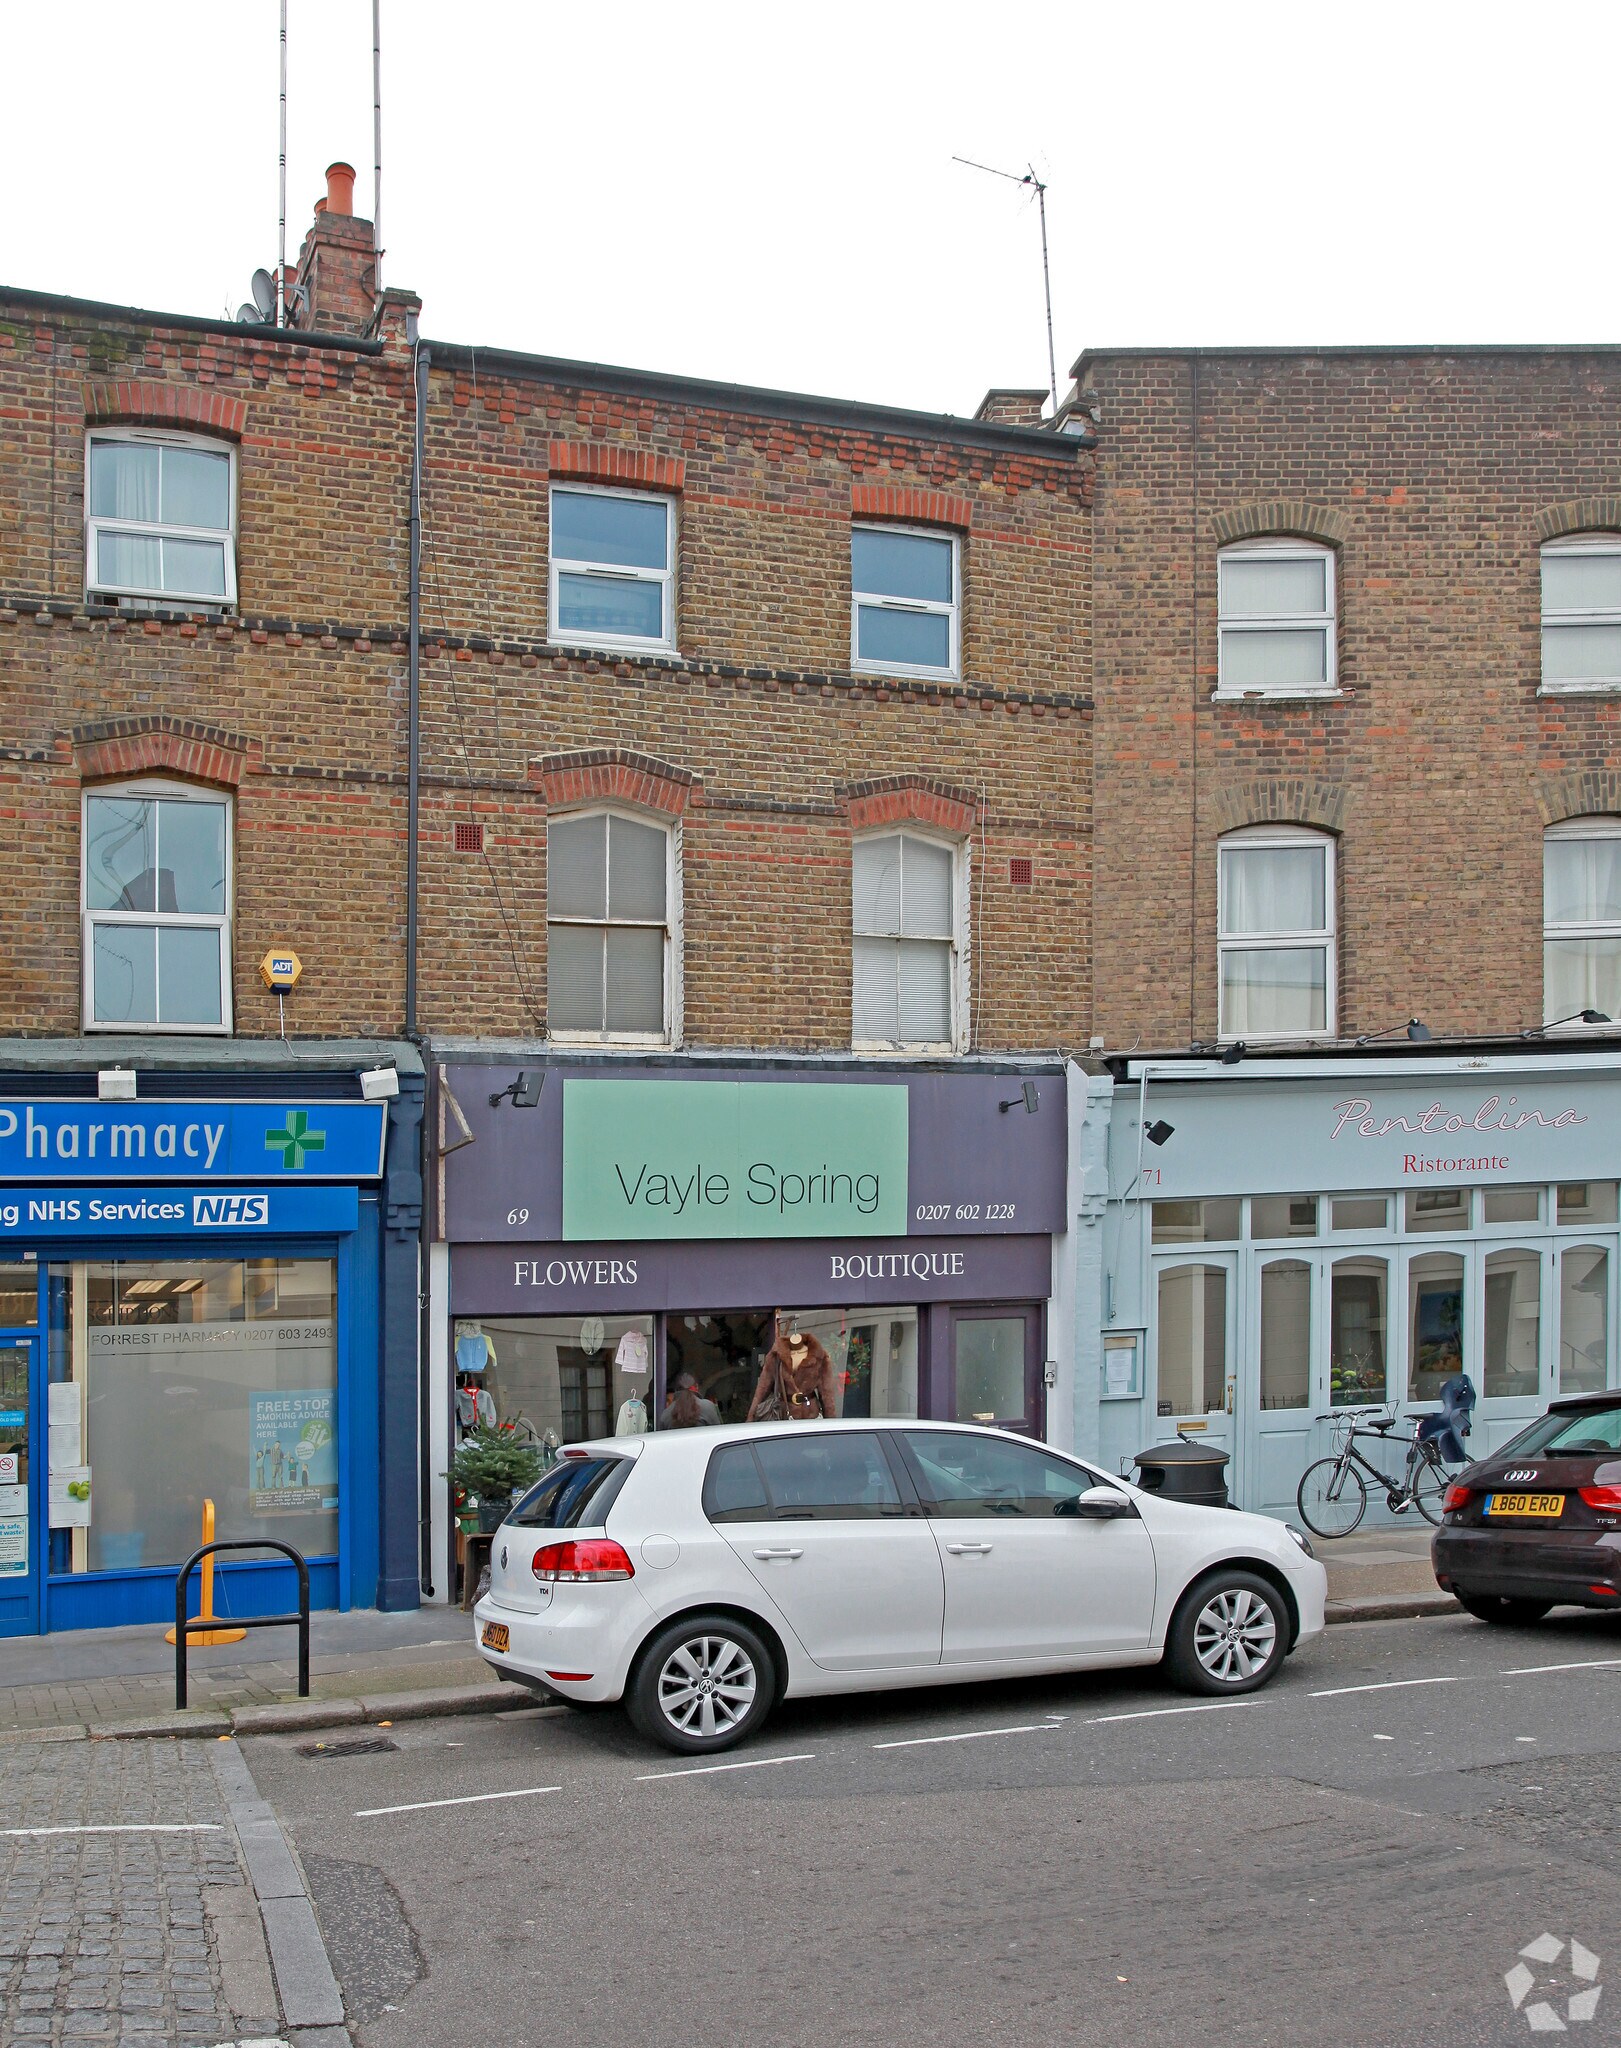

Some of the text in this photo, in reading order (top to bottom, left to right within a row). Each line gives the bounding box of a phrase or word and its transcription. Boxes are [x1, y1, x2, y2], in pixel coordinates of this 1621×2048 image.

[272, 962, 292, 971] ADT
[1330, 1095, 1588, 1140] Pentolina
[0, 1106, 225, 1169] Pharmacy
[1402, 1154, 1509, 1174] Ristorante
[1142, 1168, 1161, 1185] 71
[615, 1163, 880, 1215] Vayle Spring
[0, 1198, 185, 1226] g NHS Services
[195, 1197, 266, 1224] NHS
[506, 1208, 529, 1225] 69
[916, 1204, 1015, 1220] 0207 602 1228
[513, 1259, 638, 1286] FLOWERS
[830, 1252, 965, 1281] BOUTIQUE
[92, 1327, 333, 1346] FORREST PHARMACY 0207 603 2493
[256, 1399, 330, 1413] FREE STOP
[256, 1411, 330, 1421] SMOKING ADVICE
[256, 1421, 298, 1430] AVAILABLE
[1491, 1495, 1560, 1512] LB60 ERO
